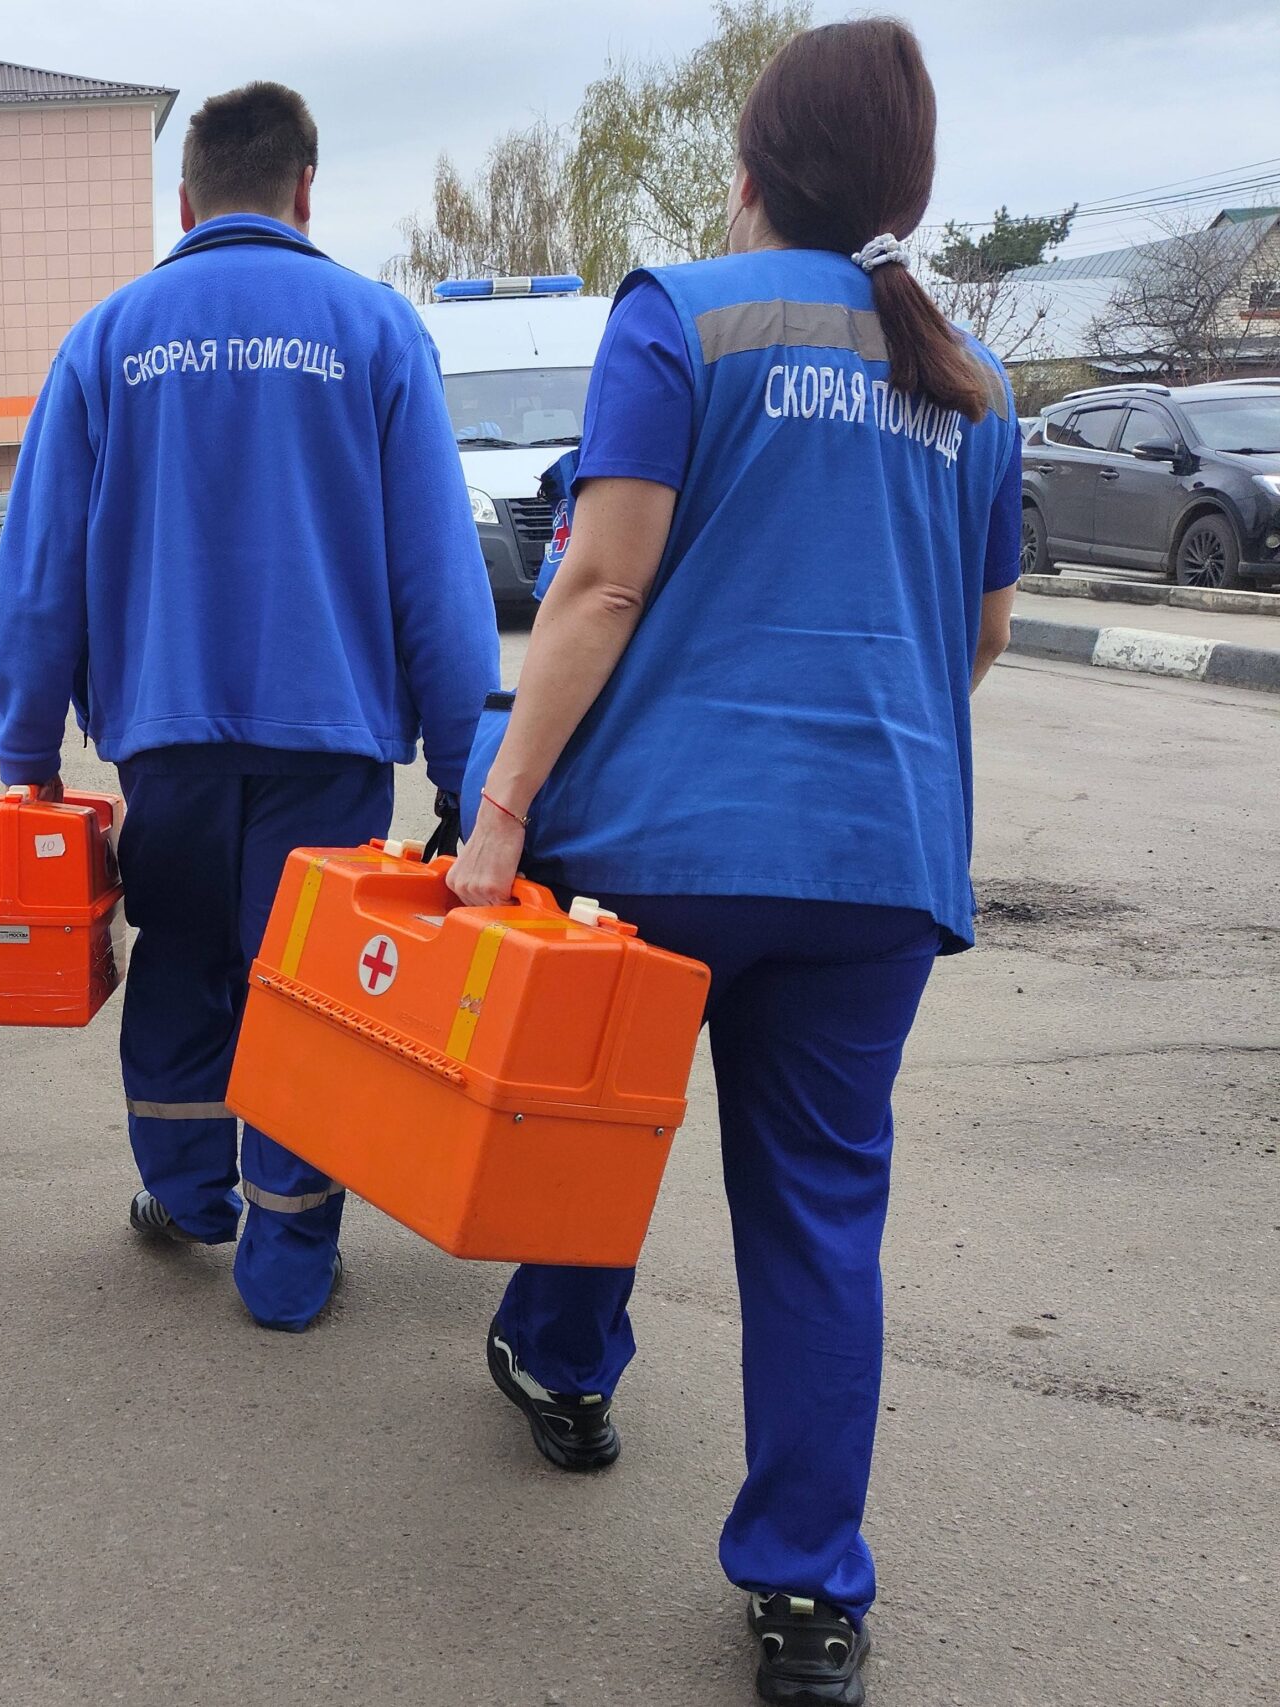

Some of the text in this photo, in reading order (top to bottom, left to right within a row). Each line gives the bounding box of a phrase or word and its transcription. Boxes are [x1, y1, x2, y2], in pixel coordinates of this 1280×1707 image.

[123, 337, 345, 385] СКОРАЯ ПОМОЩЬ
[764, 365, 962, 468] СКОРАЯ ПОМОЩЬ
[41, 840, 55, 852] 10
